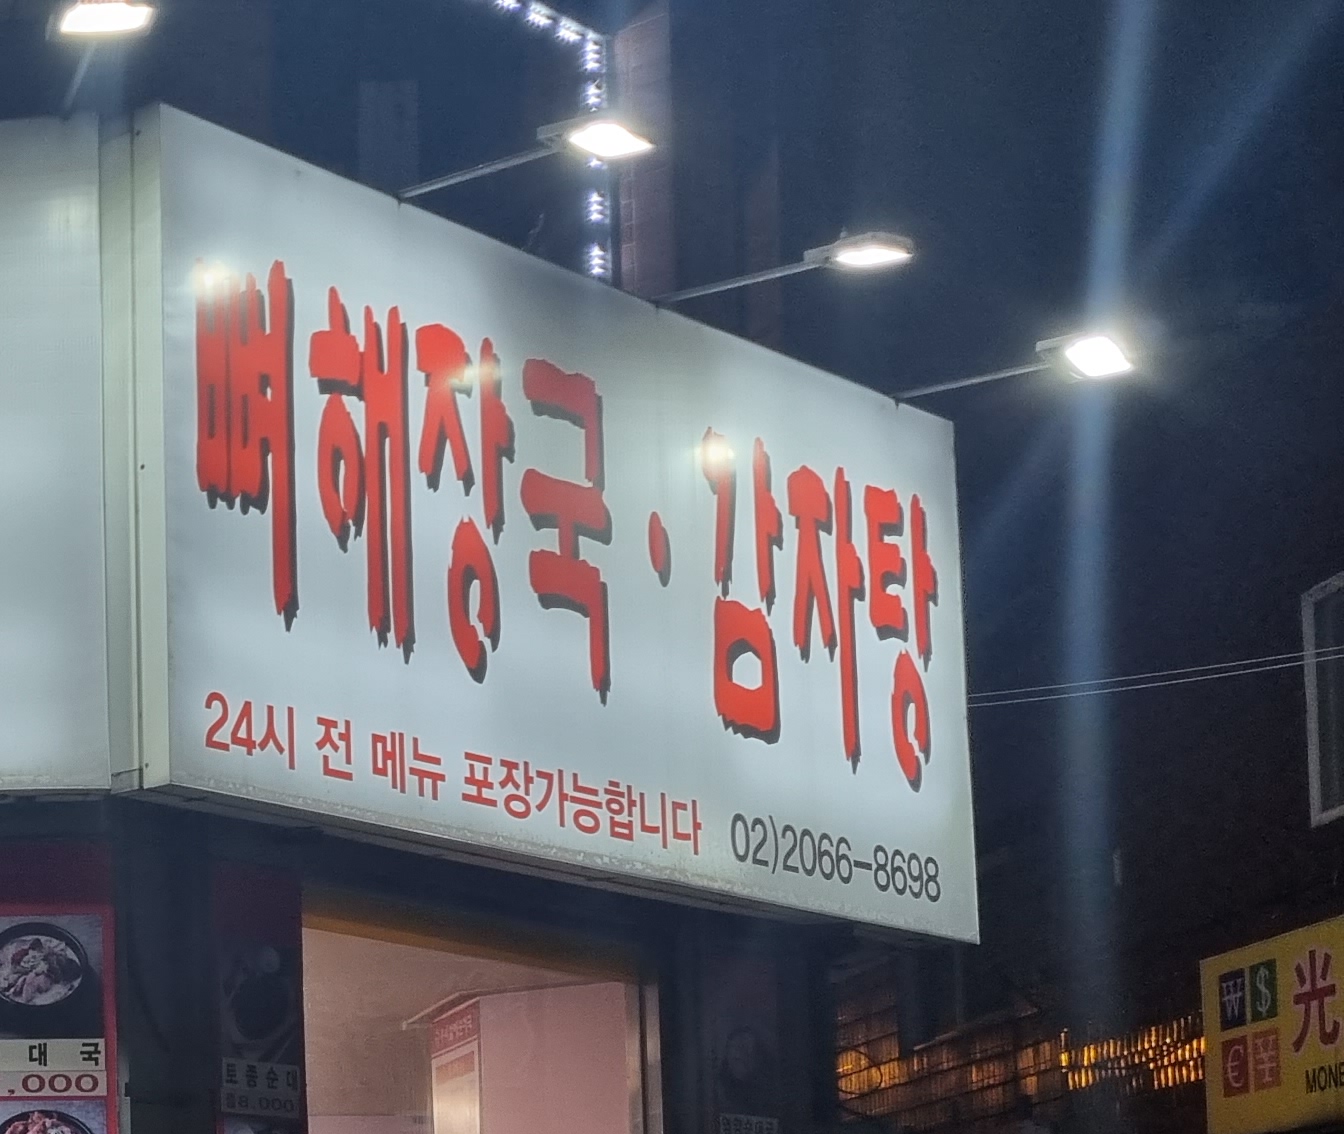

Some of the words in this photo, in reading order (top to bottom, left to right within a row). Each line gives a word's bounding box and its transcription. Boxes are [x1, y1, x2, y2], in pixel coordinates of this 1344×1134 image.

[196, 259, 611, 705] 뼈해장국
[703, 426, 939, 791] 감자탕
[203, 692, 298, 771] 24시
[315, 716, 355, 781] 전
[371, 730, 447, 799] 메뉴
[462, 750, 702, 857] 포장가능합니다
[730, 813, 942, 903] 02)2066-8698
